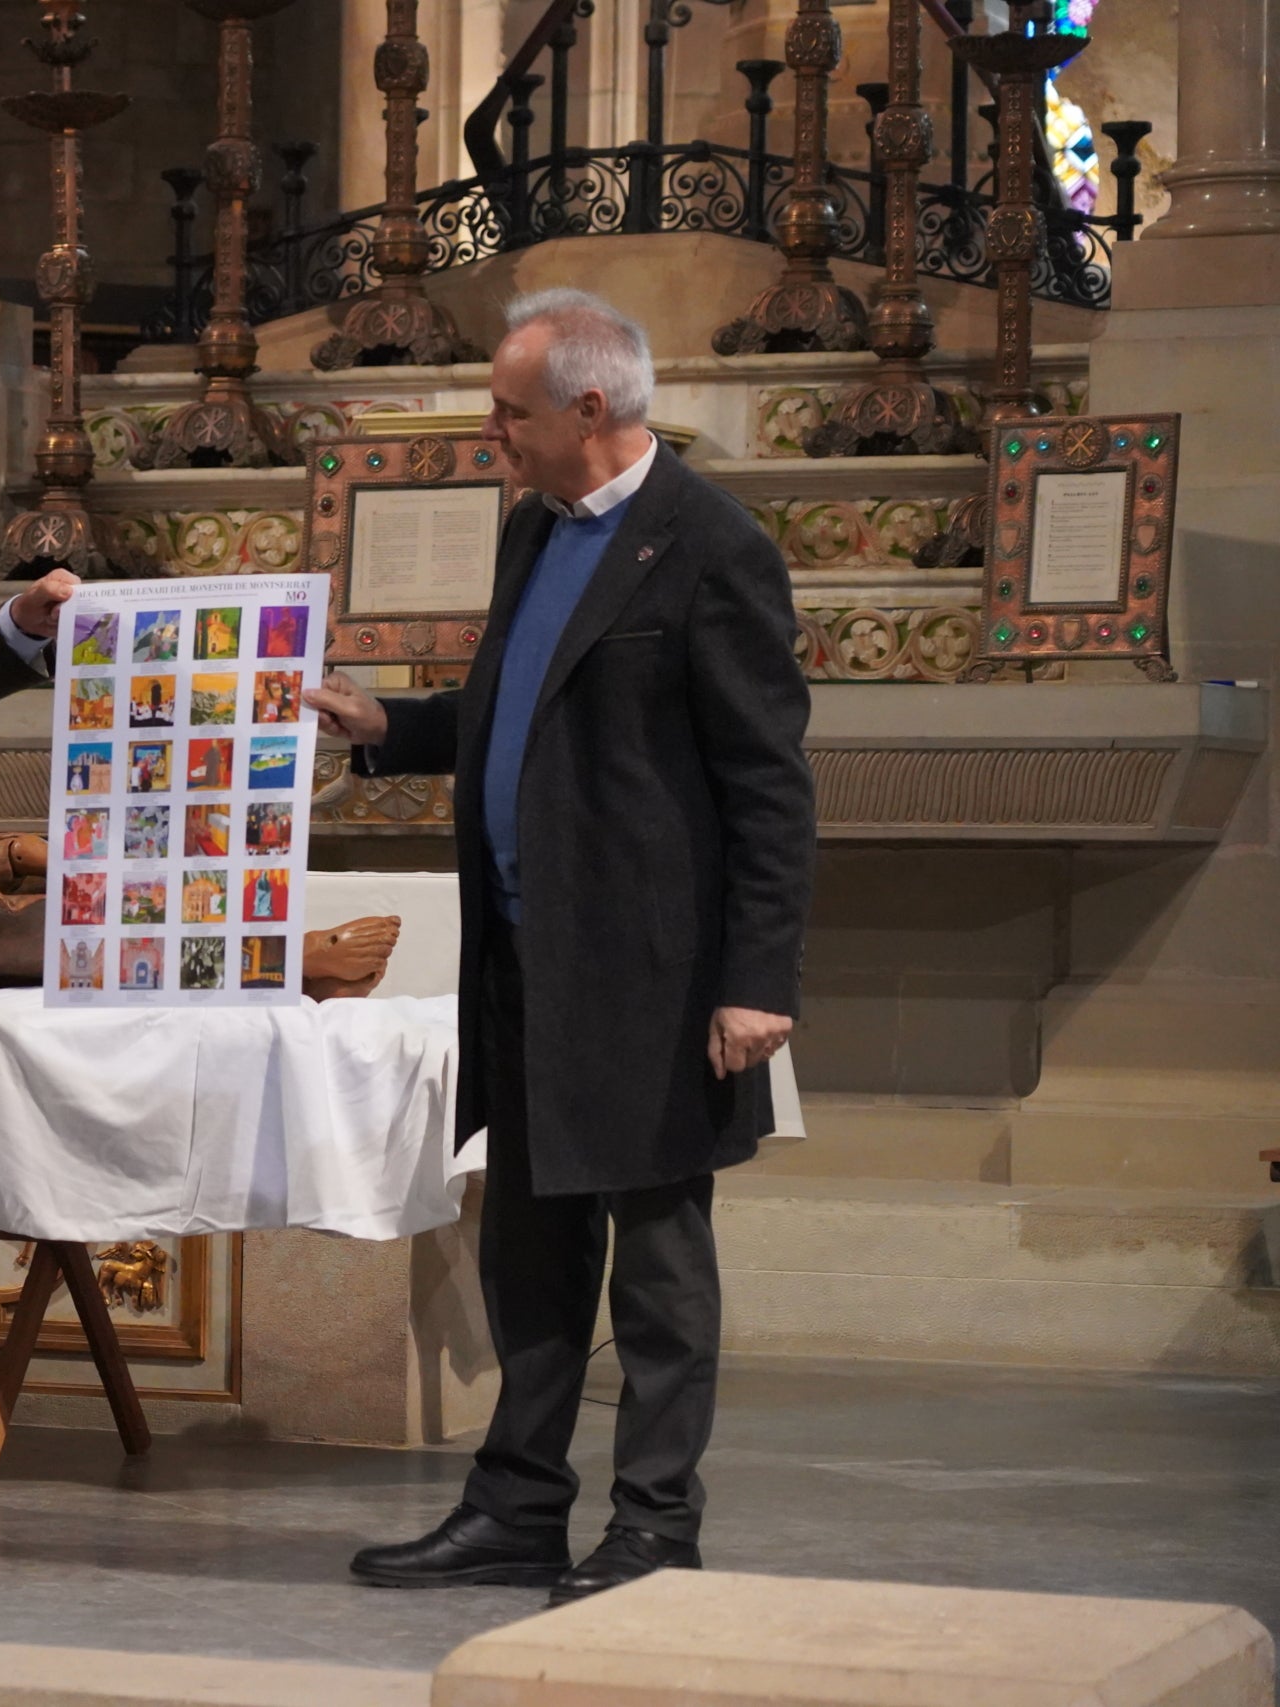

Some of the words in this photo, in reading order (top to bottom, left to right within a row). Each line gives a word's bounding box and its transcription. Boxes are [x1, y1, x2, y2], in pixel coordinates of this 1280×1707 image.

[101, 588, 117, 598] DEL
[171, 585, 187, 594] DEL
[190, 583, 234, 593] MONESTIR
[235, 582, 248, 591] DE
[250, 581, 312, 590] MONTSERRAT
